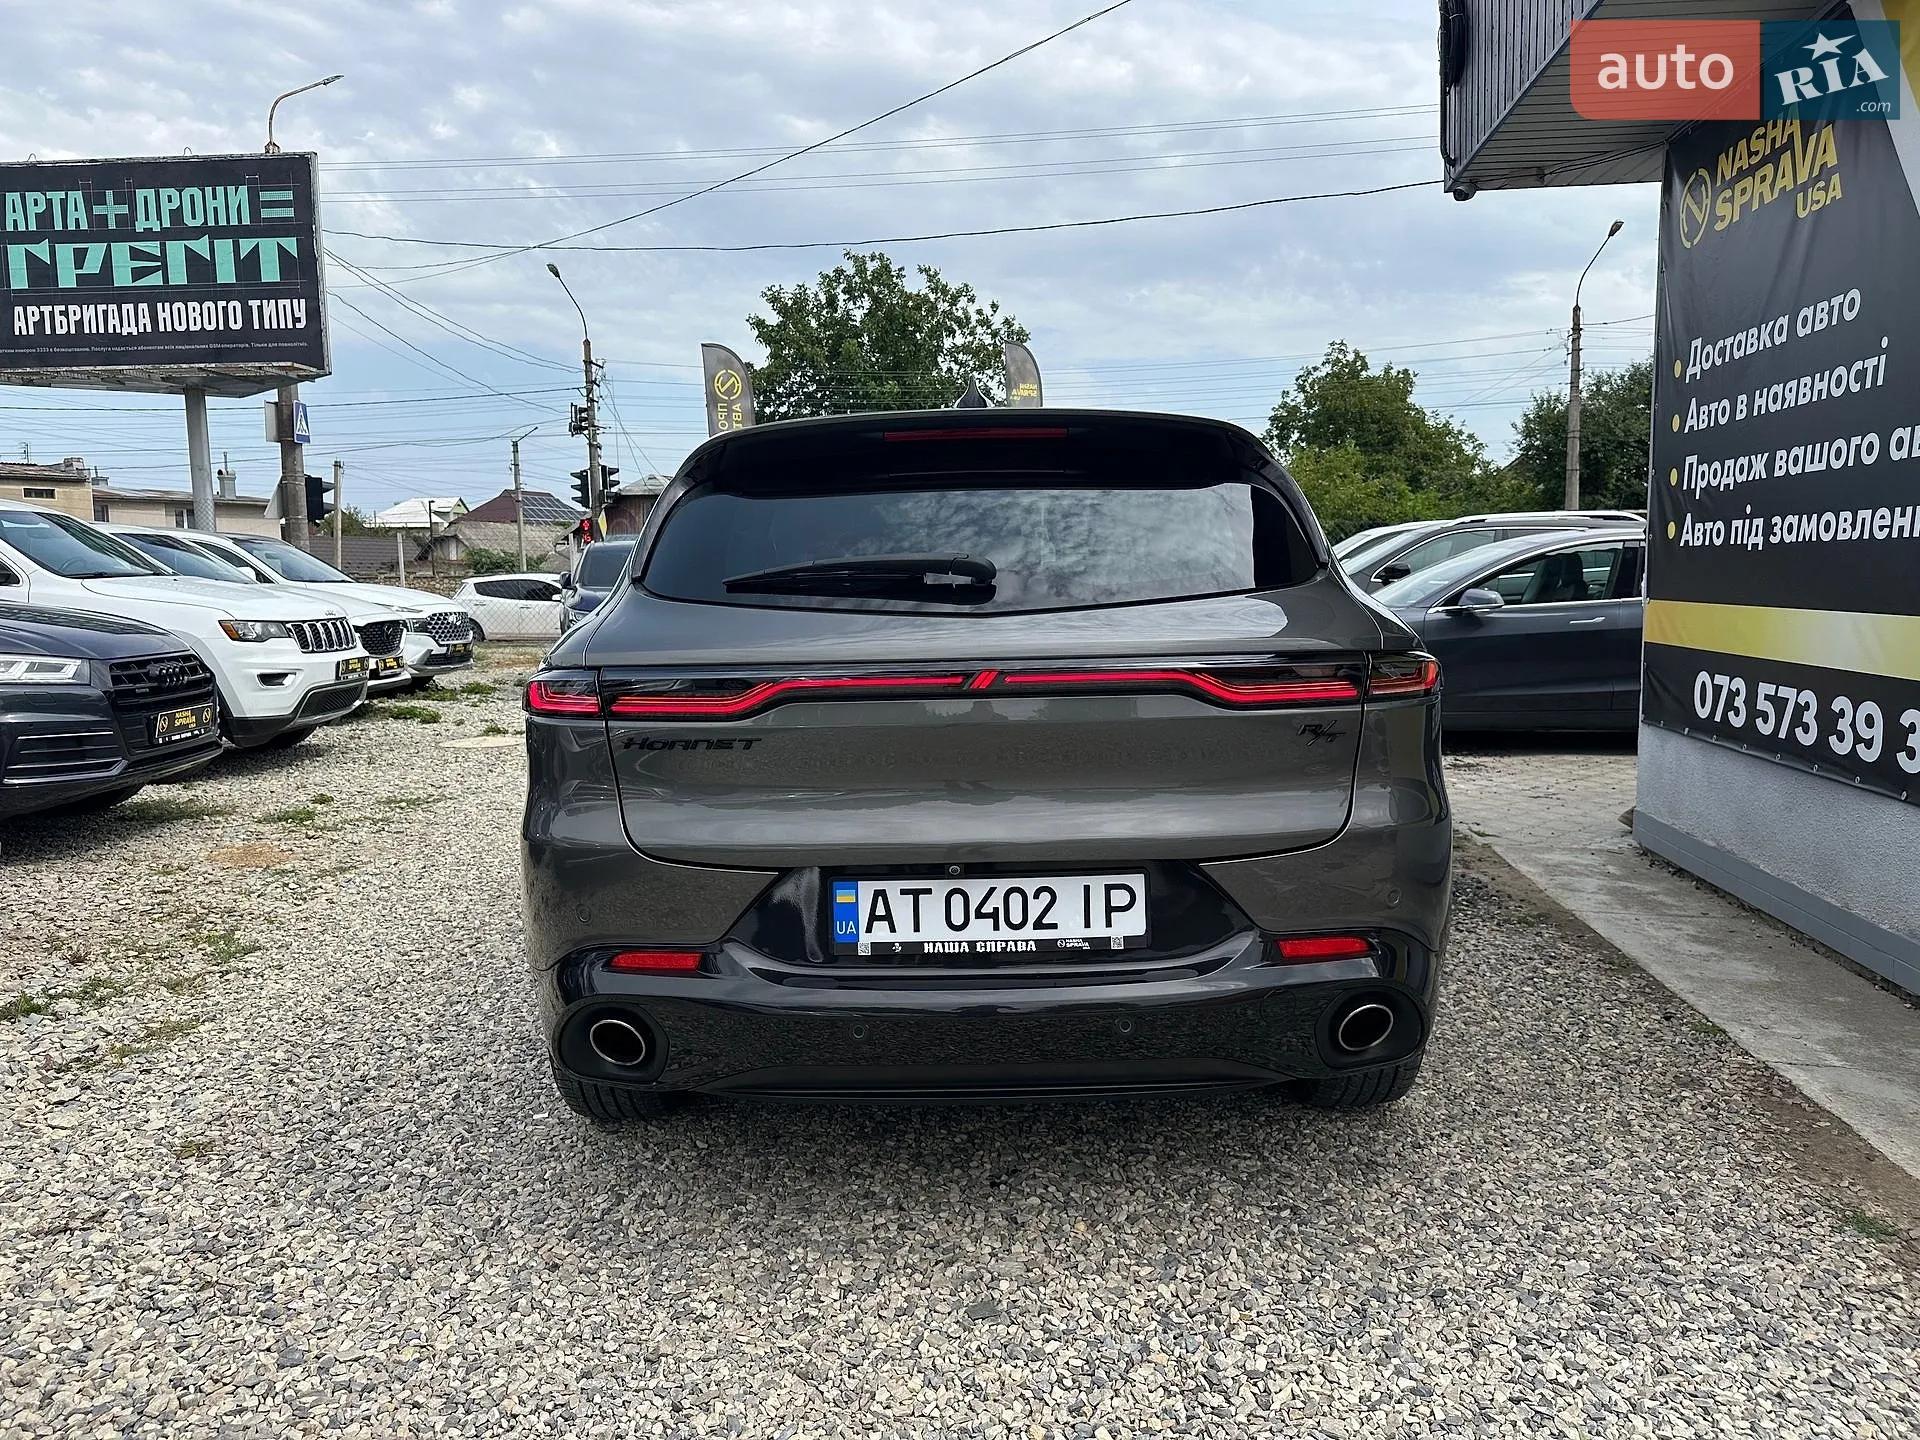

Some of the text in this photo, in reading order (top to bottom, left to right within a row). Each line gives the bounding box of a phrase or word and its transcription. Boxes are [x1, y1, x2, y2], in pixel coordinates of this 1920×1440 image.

[1715, 105, 1802, 187] NASHA
[1713, 124, 1838, 232] SPRAVA
[1796, 172, 1842, 218] USA
[13, 298, 308, 336] АРТБРИГАДА НОВОГО ТИПУ
[1685, 288, 1861, 383] Доставка авто
[1683, 336, 1889, 433] Авто в наявності
[1682, 452, 1769, 499] Продаж
[1774, 432, 1880, 478] вашого
[1680, 513, 1724, 547] Авто
[1730, 504, 1764, 550] під
[1694, 670, 1920, 774] 073 573 39 3
[836, 921, 856, 935] UA
[864, 883, 1137, 934] AT 0402 IP
[923, 940, 1037, 954] НАША СПРАВА
